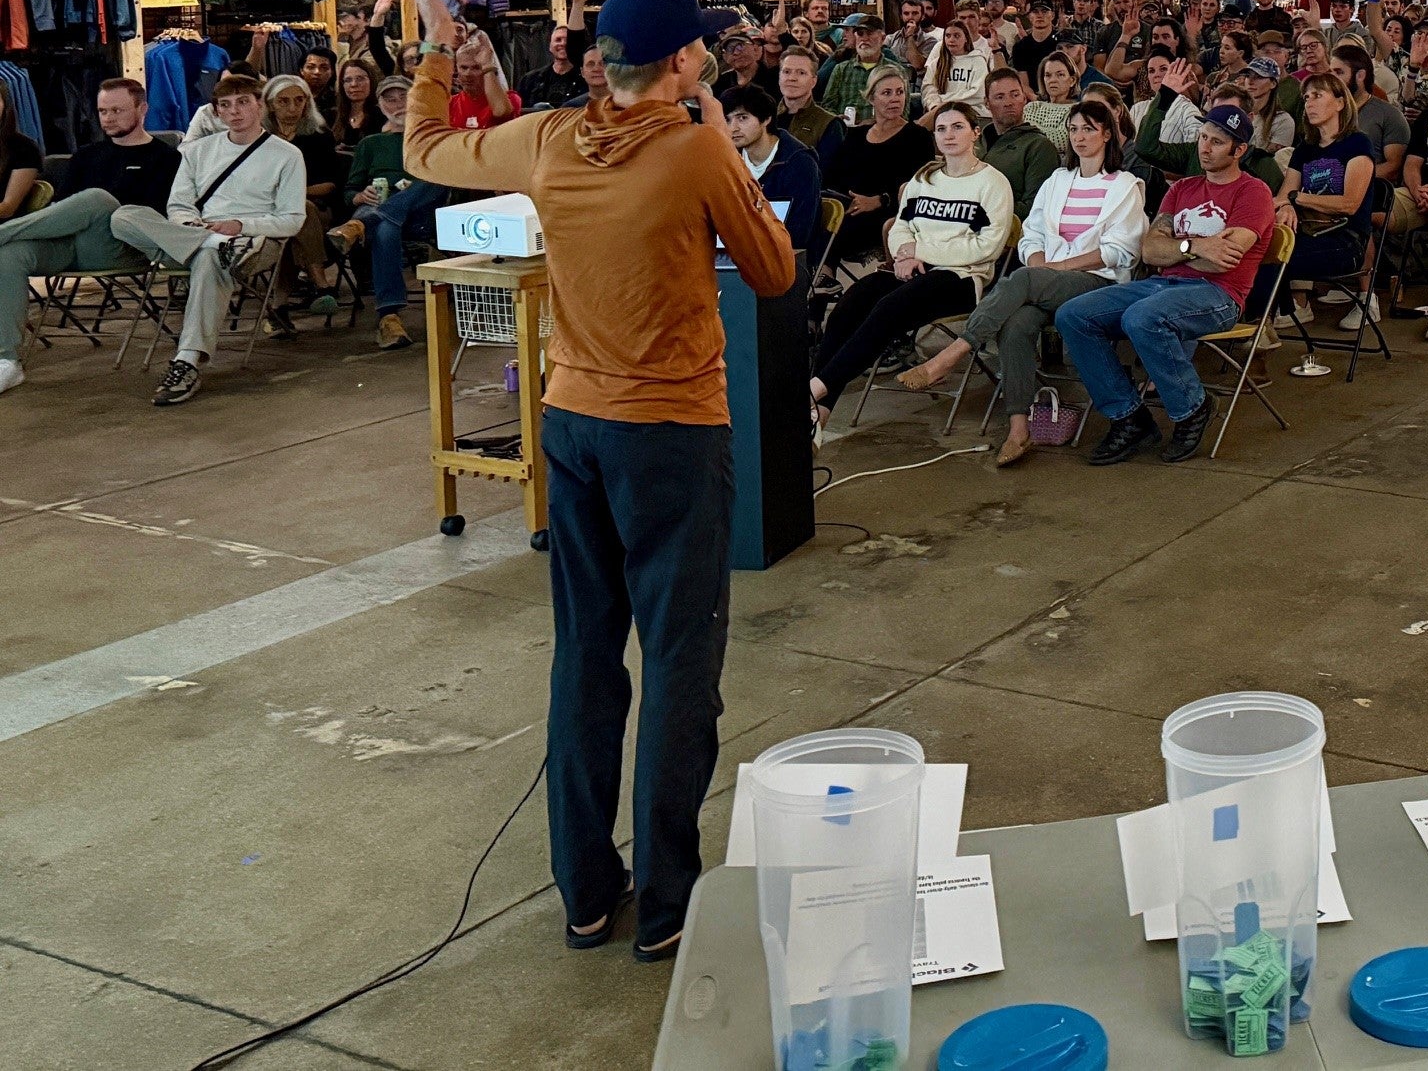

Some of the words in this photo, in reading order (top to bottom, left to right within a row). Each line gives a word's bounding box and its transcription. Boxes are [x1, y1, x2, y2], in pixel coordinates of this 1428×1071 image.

[914, 198, 978, 221] YOSEMITE
[1251, 969, 1276, 996] TICKET
[1237, 1019, 1249, 1047] TICKET
